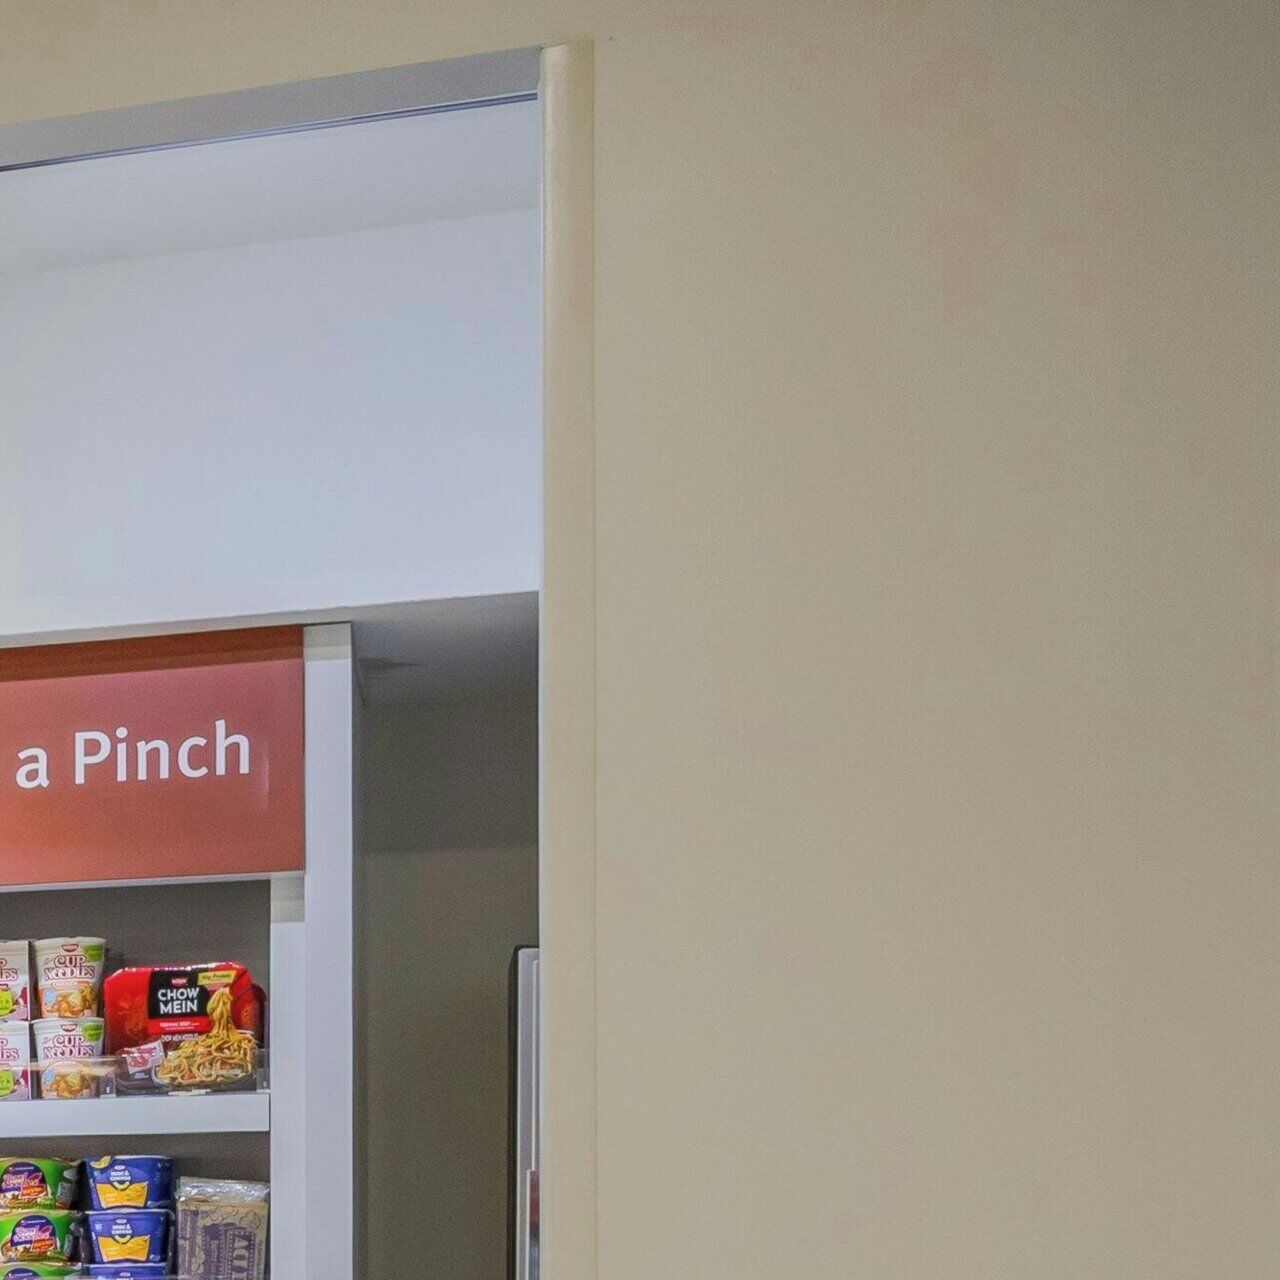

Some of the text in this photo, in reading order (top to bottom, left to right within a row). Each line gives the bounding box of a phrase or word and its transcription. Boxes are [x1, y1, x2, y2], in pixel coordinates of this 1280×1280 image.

[15, 746, 50, 788] a
[74, 719, 250, 785] Pinch
[54, 955, 86, 968] CUP
[44, 966, 95, 980] NOODLES
[157, 987, 200, 1001] CHOW
[160, 1000, 198, 1014] MEIN
[52, 1035, 85, 1048] CUP
